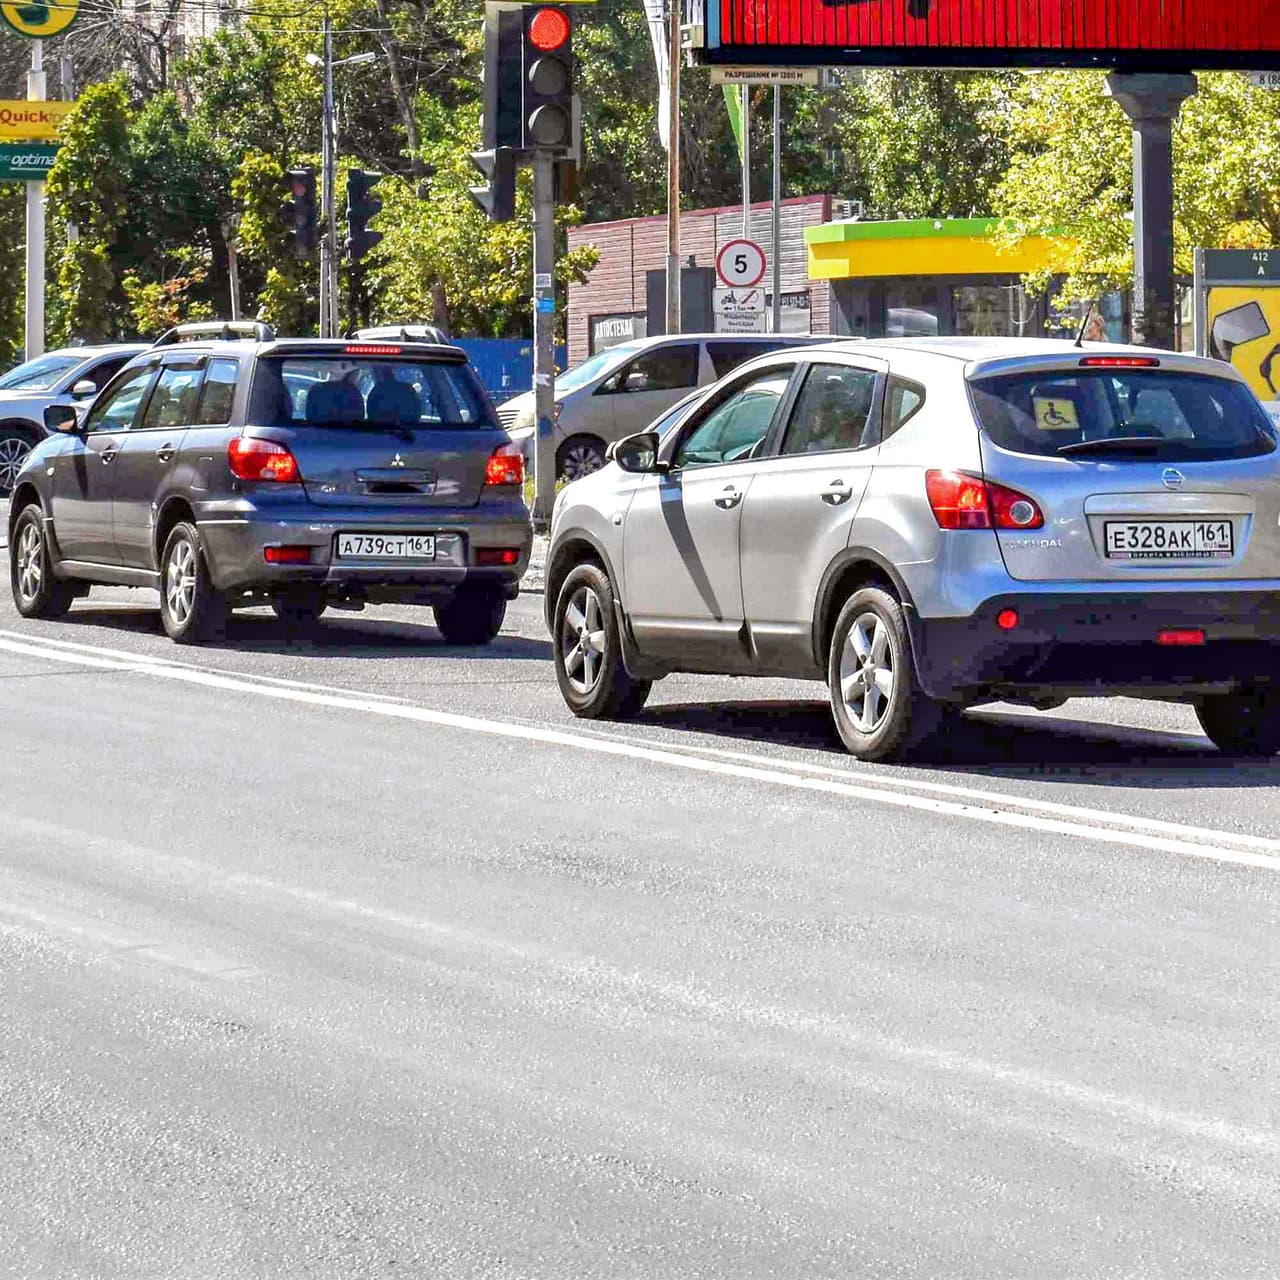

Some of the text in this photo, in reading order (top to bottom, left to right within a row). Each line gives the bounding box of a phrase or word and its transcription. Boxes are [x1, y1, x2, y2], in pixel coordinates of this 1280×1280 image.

[1258, 74, 1266, 85] 8
[10, 153, 57, 167] optima
[734, 254, 748, 274] 5
[1251, 252, 1269, 262] 412
[1113, 524, 1225, 549] Е328АК 161
[343, 537, 432, 555] А739СТ 161
